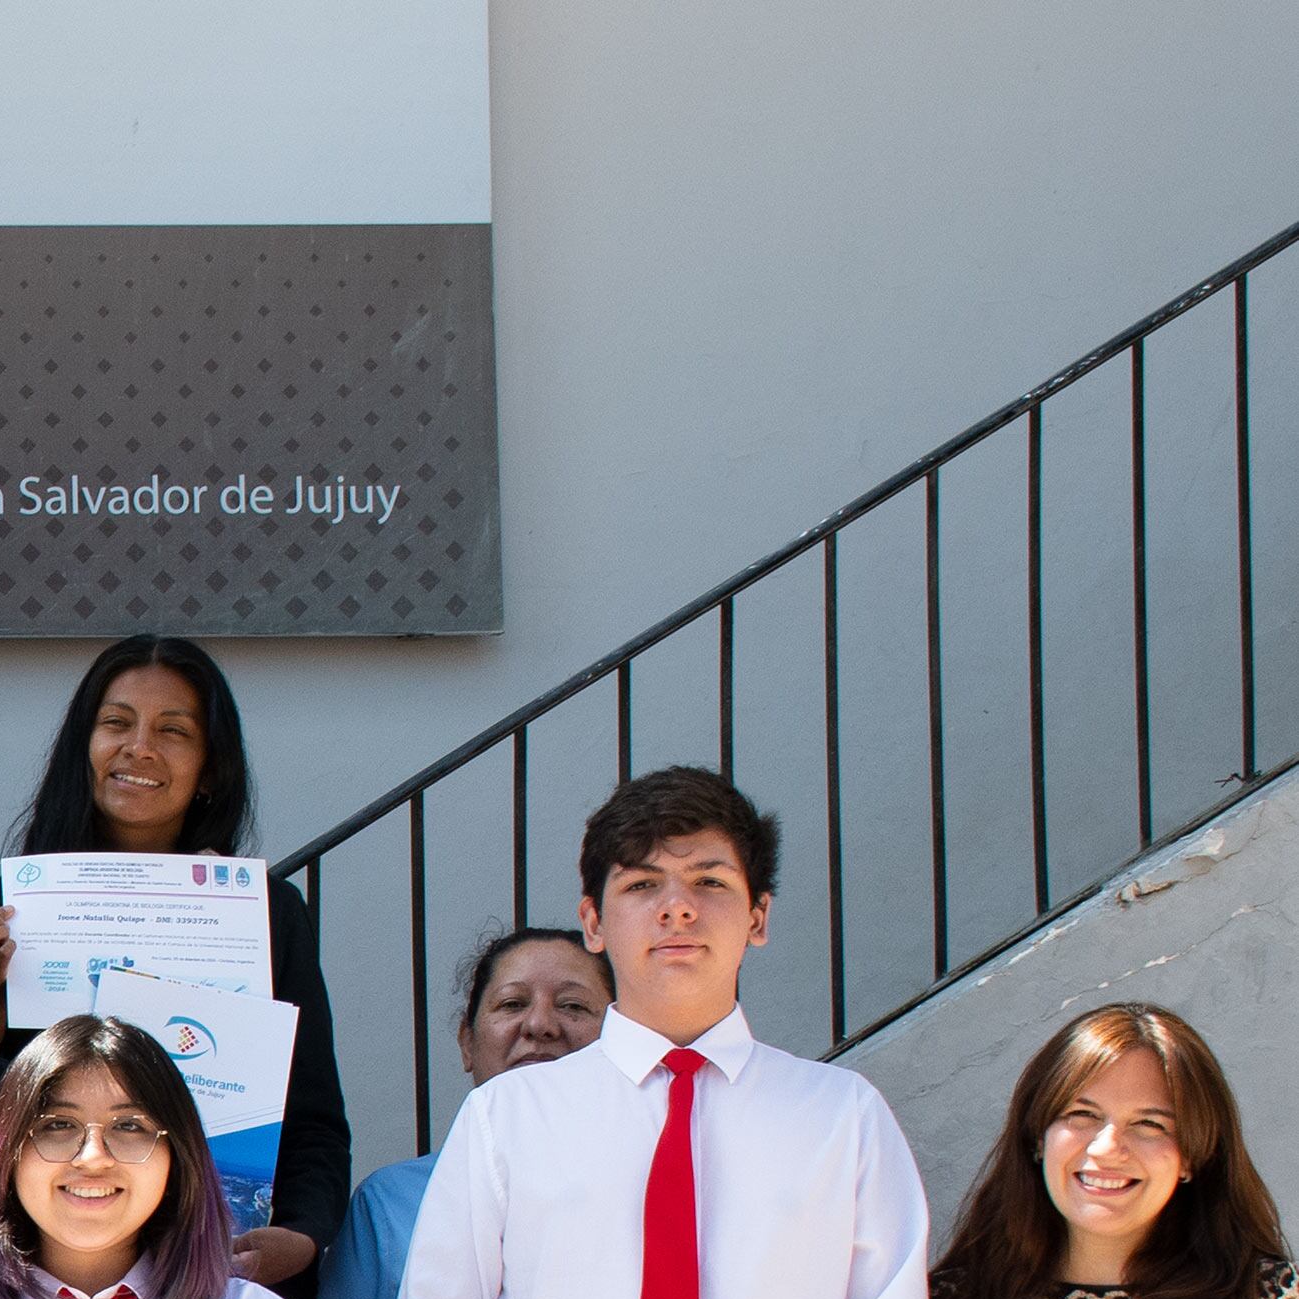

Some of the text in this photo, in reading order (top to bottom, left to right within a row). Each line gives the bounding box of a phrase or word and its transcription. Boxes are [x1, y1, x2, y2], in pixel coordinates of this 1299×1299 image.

[18, 475, 207, 515] Salvador
[219, 475, 274, 515] de
[286, 475, 401, 524] Jujuy
